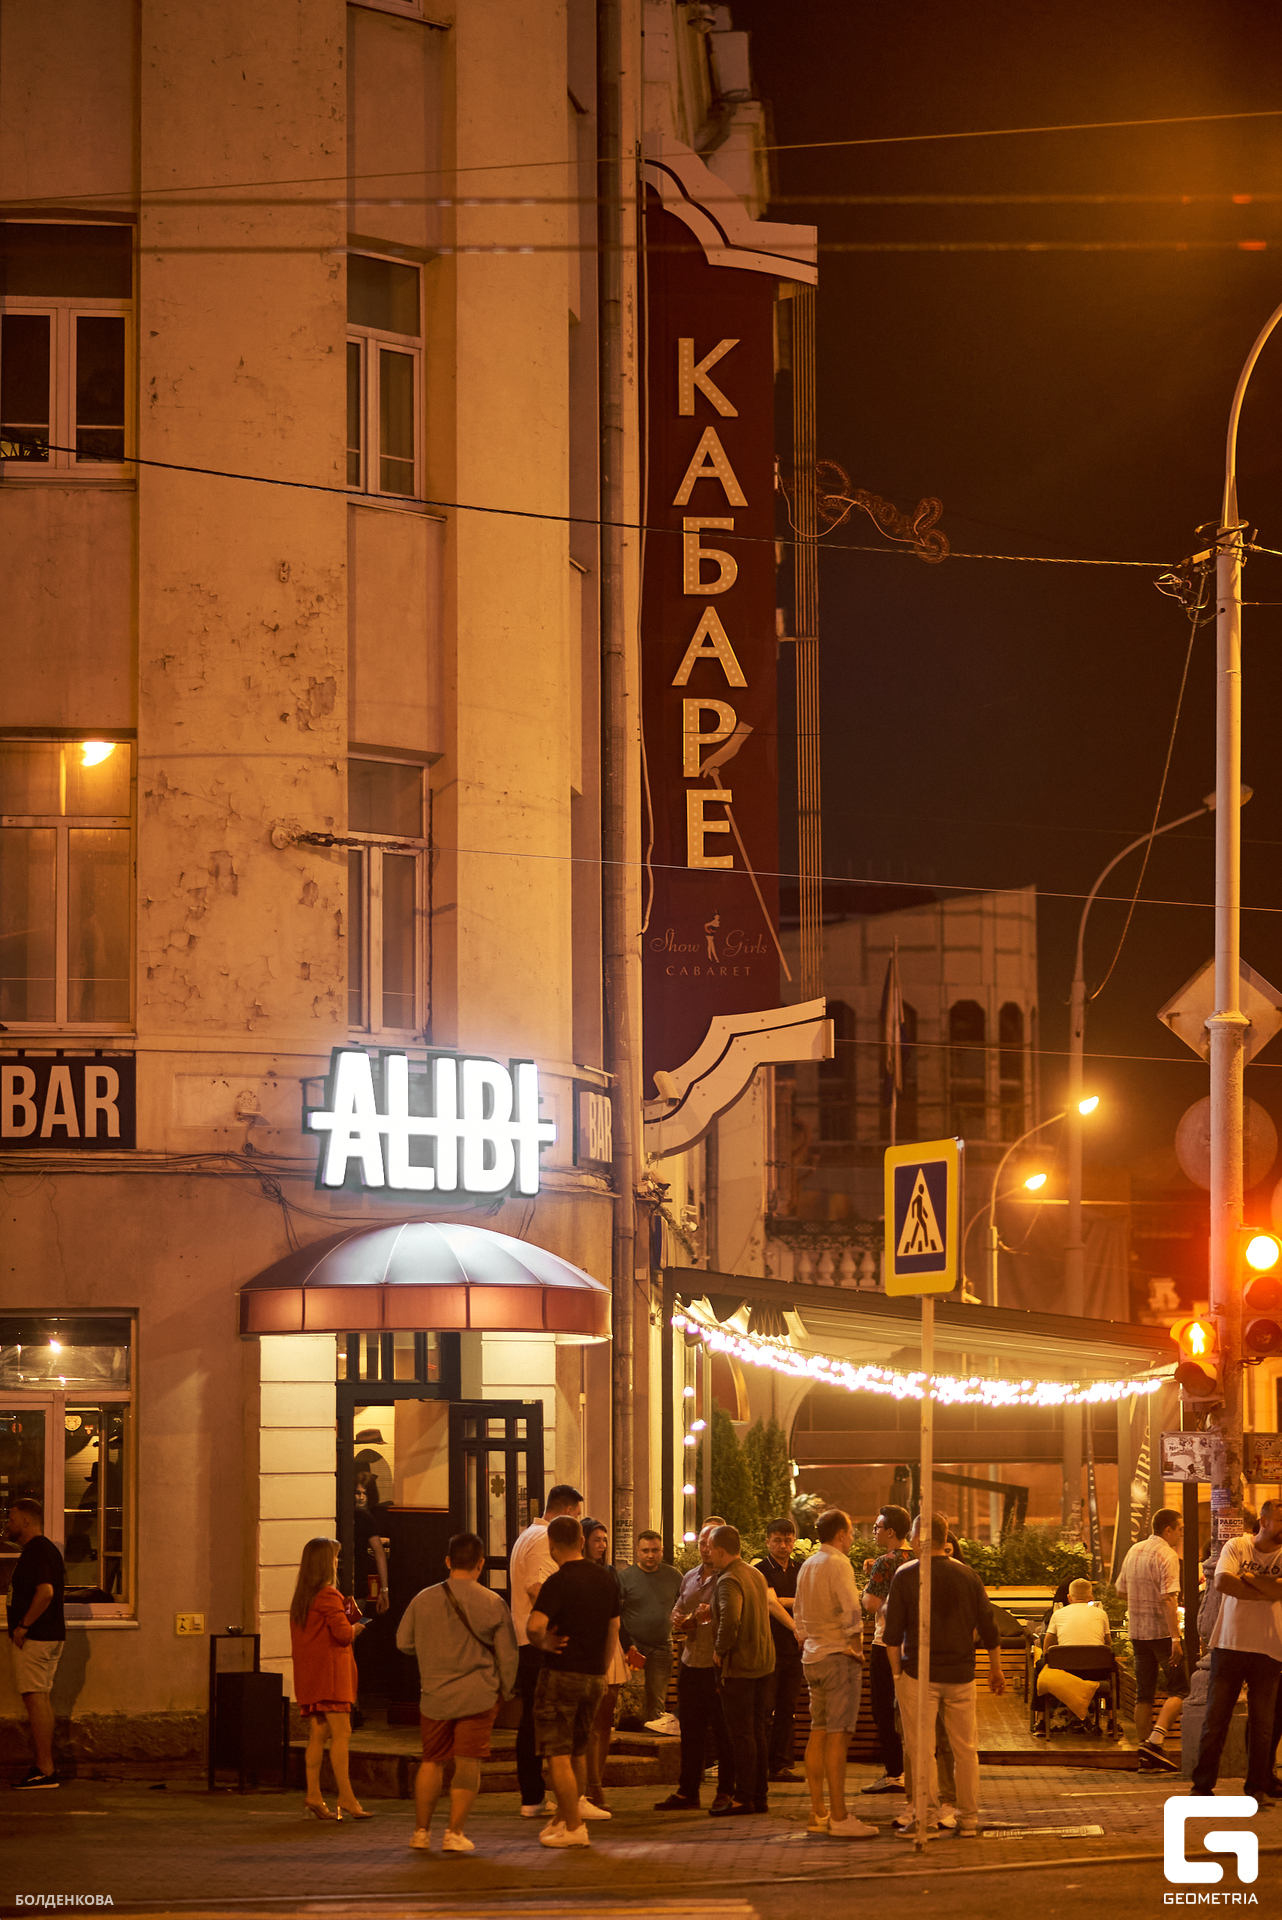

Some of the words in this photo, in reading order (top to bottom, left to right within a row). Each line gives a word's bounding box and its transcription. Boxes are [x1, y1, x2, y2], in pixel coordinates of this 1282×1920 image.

[672, 337, 749, 869] КАБАРЕ
[650, 927, 700, 952] Show
[722, 929, 768, 957] Girls
[665, 965, 752, 977] CABARET
[1, 1065, 121, 1138] BAR
[318, 1051, 546, 1195] ALIBI
[588, 1091, 613, 1163] BAR
[1241, 1559, 1281, 1575] HELLO
